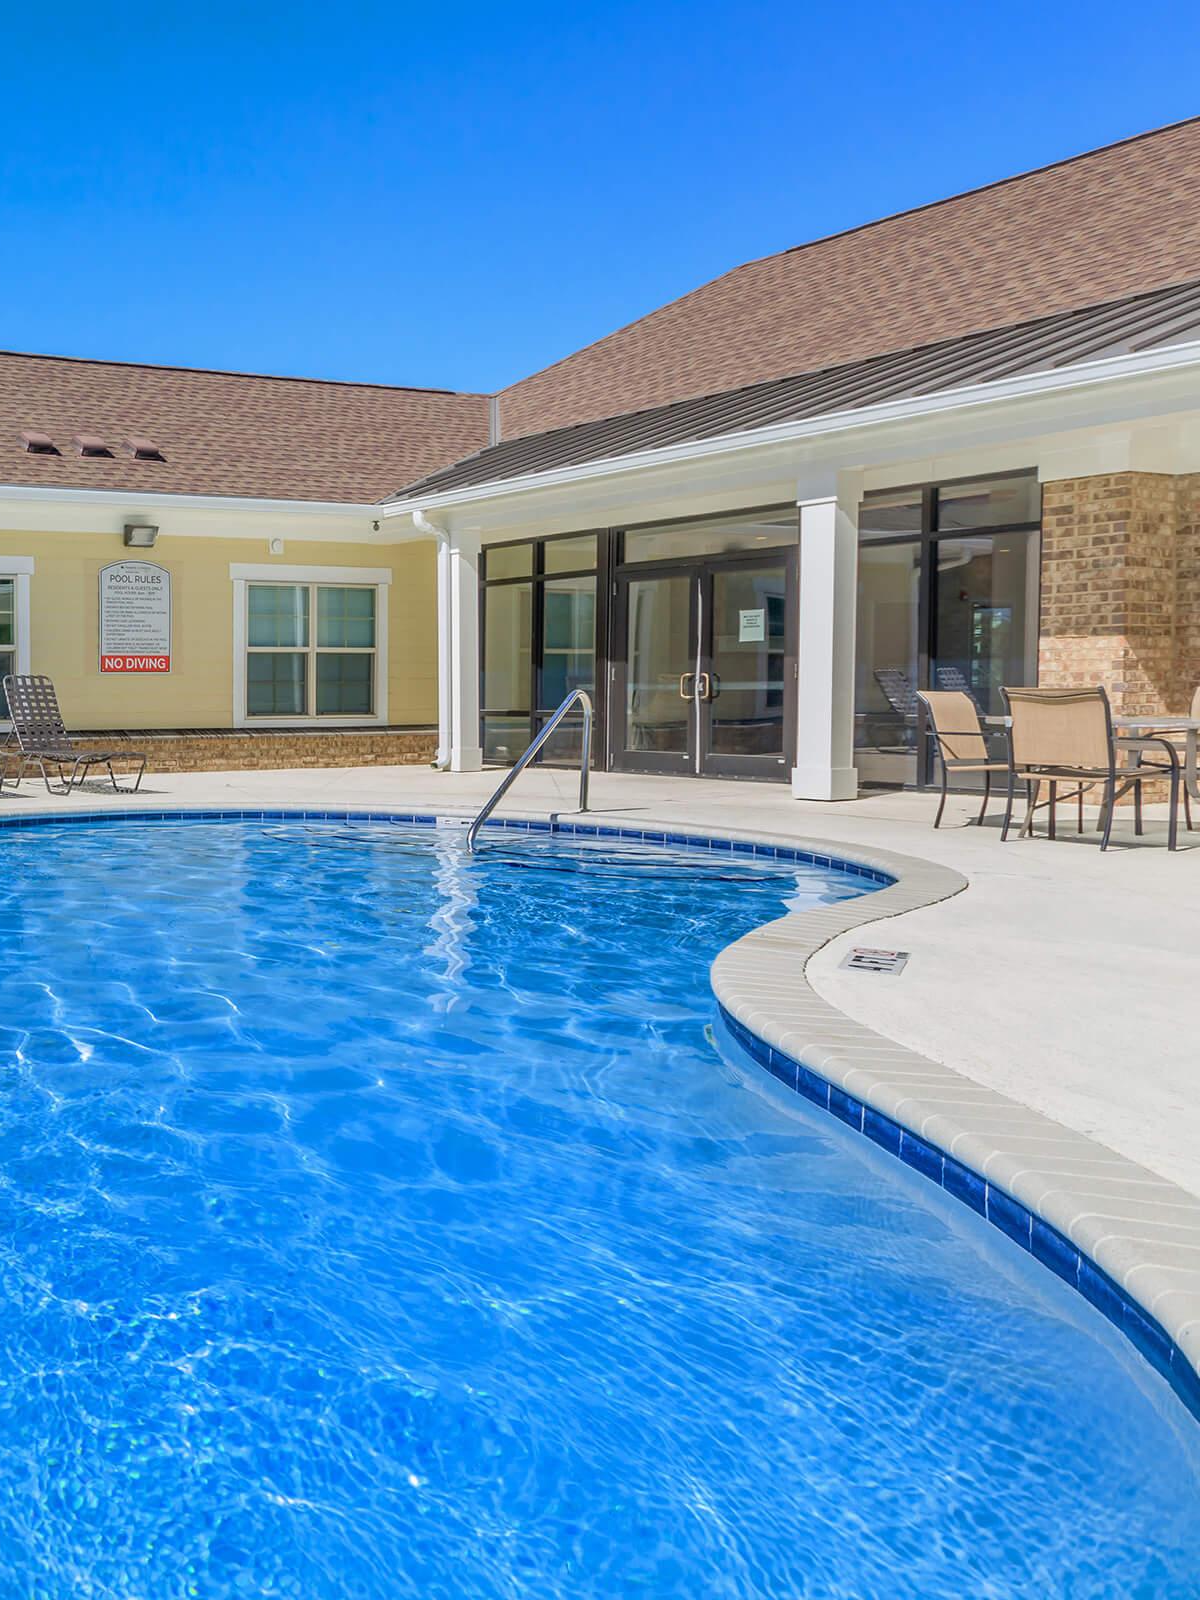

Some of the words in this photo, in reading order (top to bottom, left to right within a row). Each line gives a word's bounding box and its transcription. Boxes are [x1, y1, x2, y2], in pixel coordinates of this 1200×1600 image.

[110, 574, 133, 583] POOL
[134, 575, 162, 584] RULES
[105, 657, 123, 669] NO
[126, 658, 166, 669] DIVING
